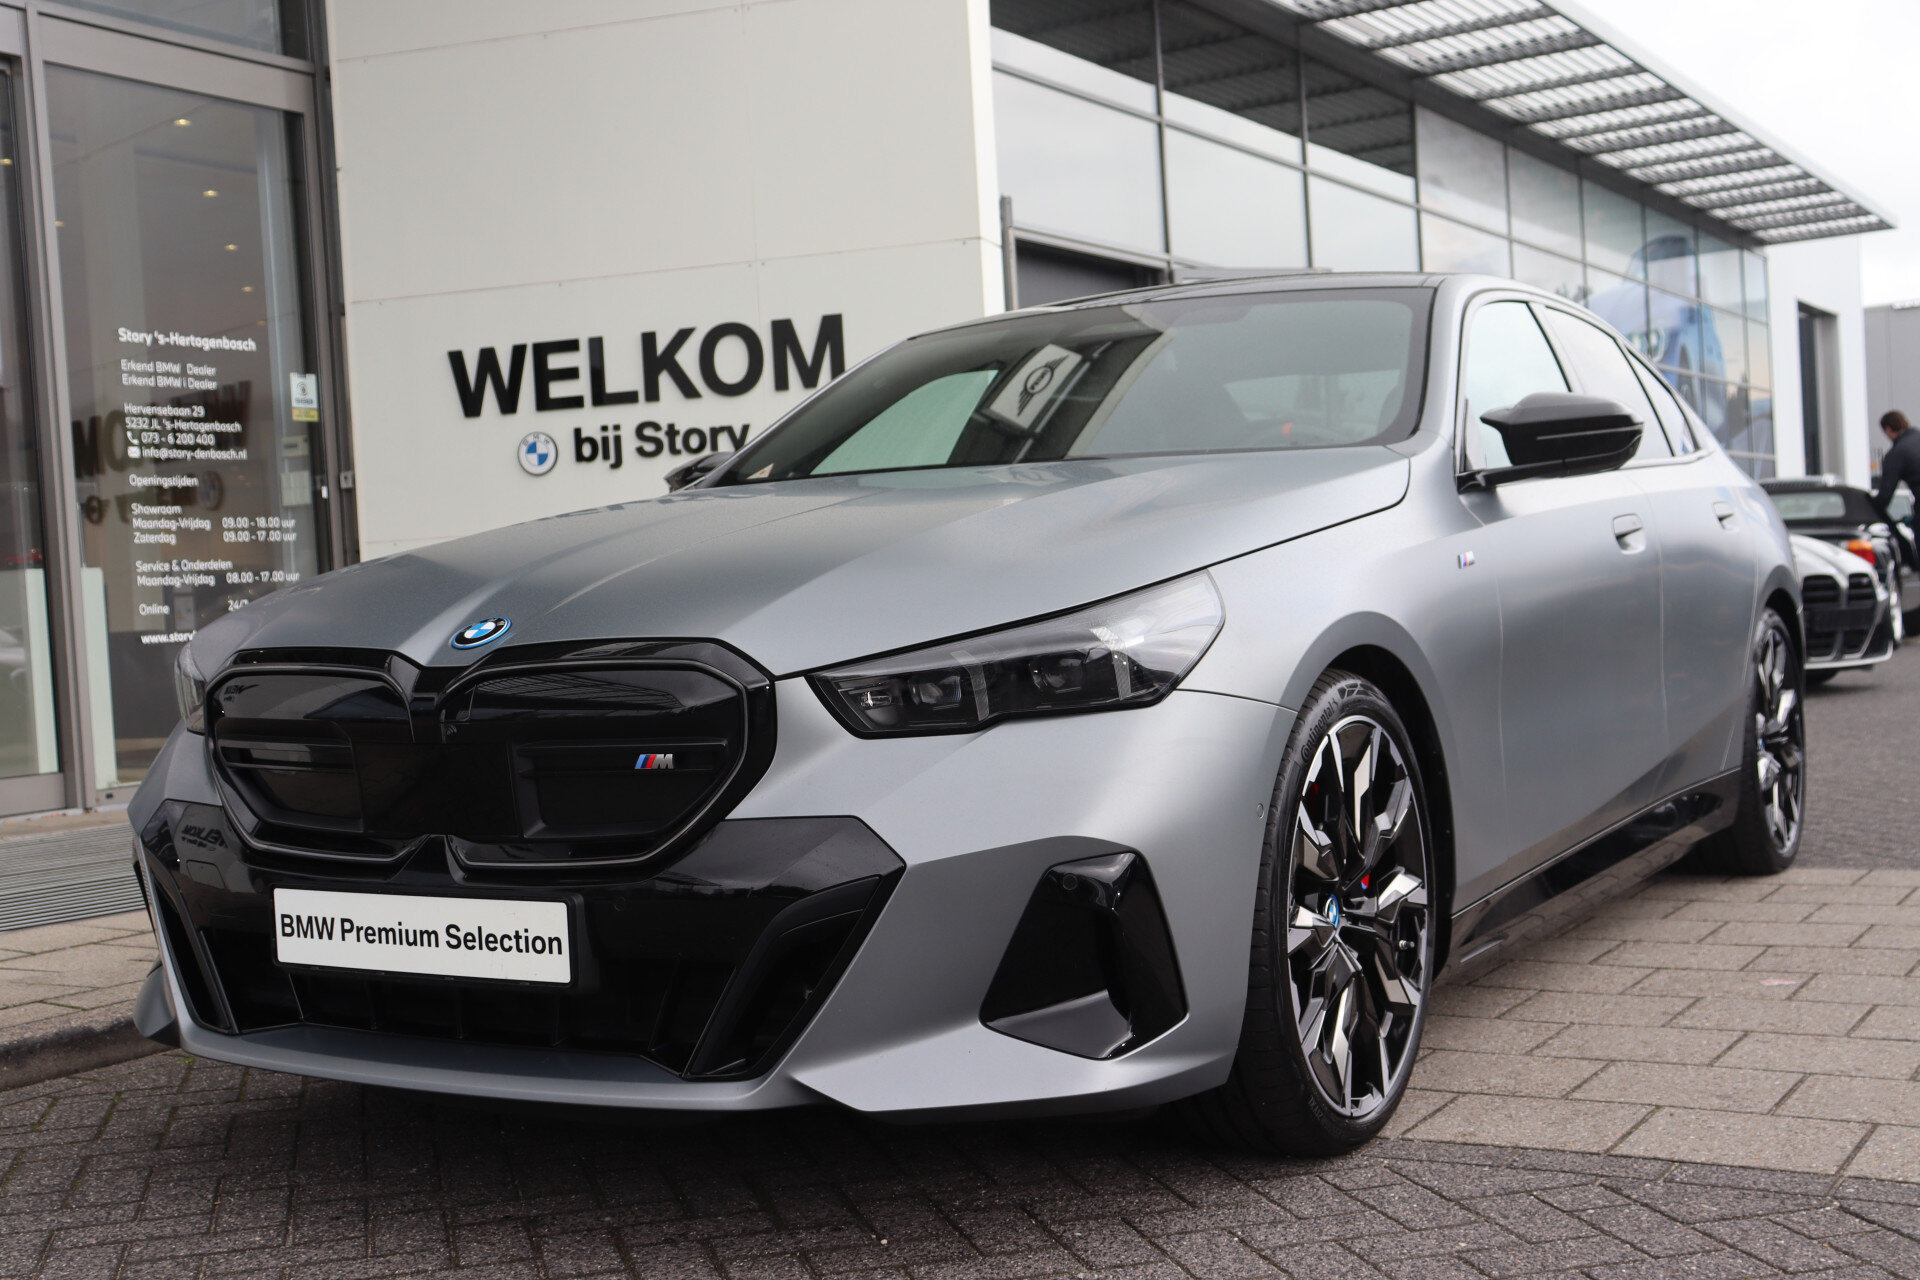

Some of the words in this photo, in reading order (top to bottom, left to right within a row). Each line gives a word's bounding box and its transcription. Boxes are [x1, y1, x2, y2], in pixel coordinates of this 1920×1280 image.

[118, 327, 152, 346] Story
[154, 330, 257, 351] 's-Hertogenbosch
[121, 359, 154, 373] Erkend
[155, 361, 181, 374] BMW
[186, 363, 217, 376] Dealer
[447, 313, 845, 418] WELKOM
[122, 373, 155, 386] Erkend
[157, 375, 182, 388] BMW
[187, 377, 218, 390] Dealer
[192, 405, 205, 417] 29
[125, 417, 149, 429] 5232
[141, 431, 159, 444] 073
[167, 432, 175, 445] 6
[175, 433, 195, 445] 200
[195, 433, 216, 446] 400
[573, 424, 624, 469] bij
[635, 421, 751, 458] Story
[129, 474, 199, 489] Openingstijden
[131, 503, 182, 515] Showroom
[132, 518, 212, 531] Maandag-Vrijdag
[222, 517, 249, 529] 09.00
[255, 516, 281, 528] 18.00
[281, 518, 296, 528] uur
[133, 532, 177, 545] Zaterdag
[222, 530, 250, 542] 09.00
[282, 532, 297, 542] uur
[135, 560, 170, 572] Service
[171, 560, 180, 571] &
[181, 559, 233, 571] Onderdelen
[136, 573, 216, 587] Maandag-Vrijdag
[226, 572, 253, 584] 08.00
[285, 572, 300, 582] uur
[139, 603, 170, 615] Online
[280, 913, 335, 940] BMW
[340, 918, 439, 948] Premium
[445, 924, 563, 955] Selection
